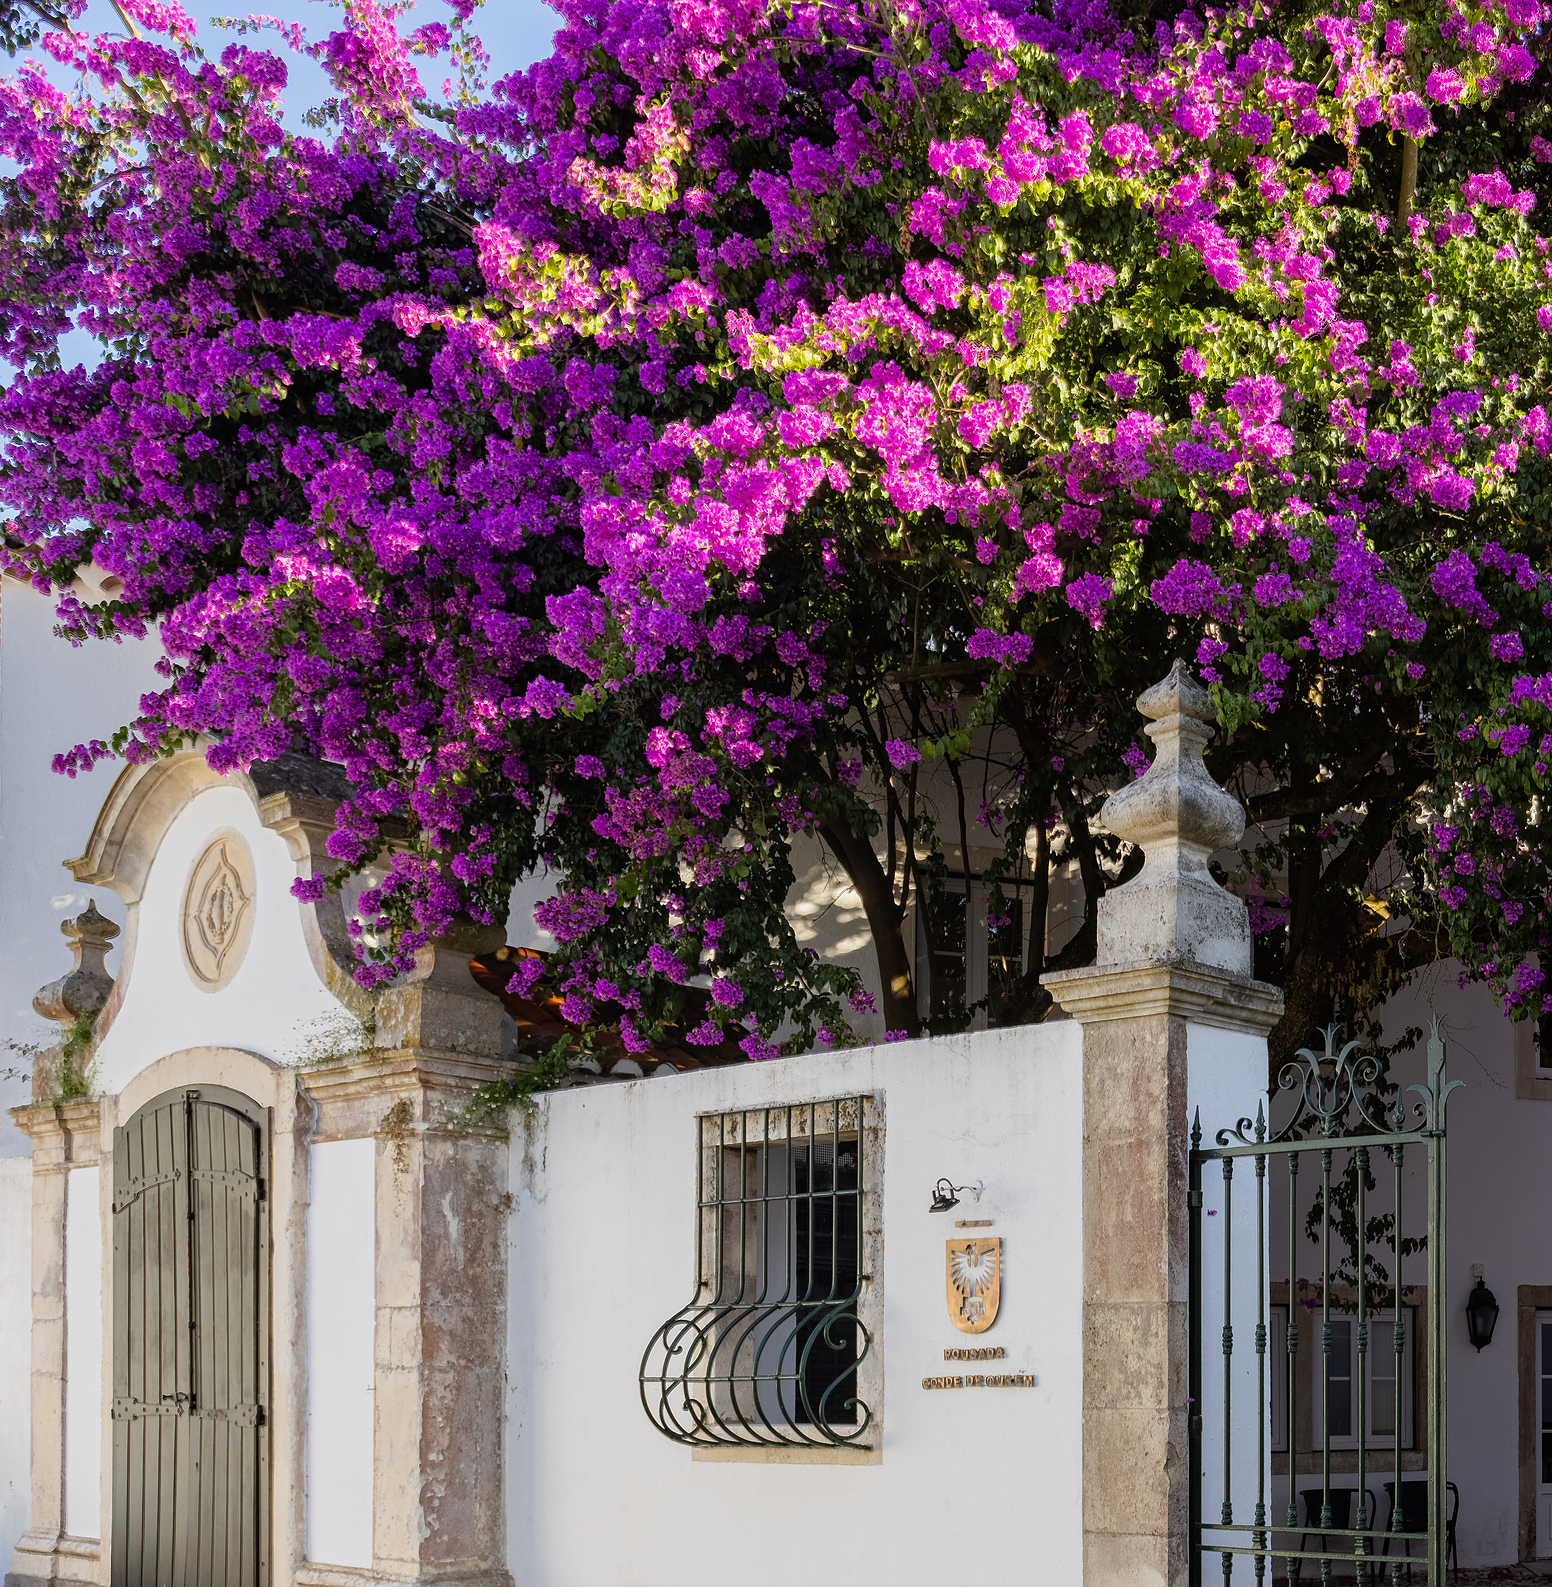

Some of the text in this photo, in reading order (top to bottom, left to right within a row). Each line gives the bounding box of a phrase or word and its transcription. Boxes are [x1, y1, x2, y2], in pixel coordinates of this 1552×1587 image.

[944, 1347, 1005, 1360] POUSADA
[922, 1376, 963, 1390] CONDE
[965, 1375, 984, 1387] DE
